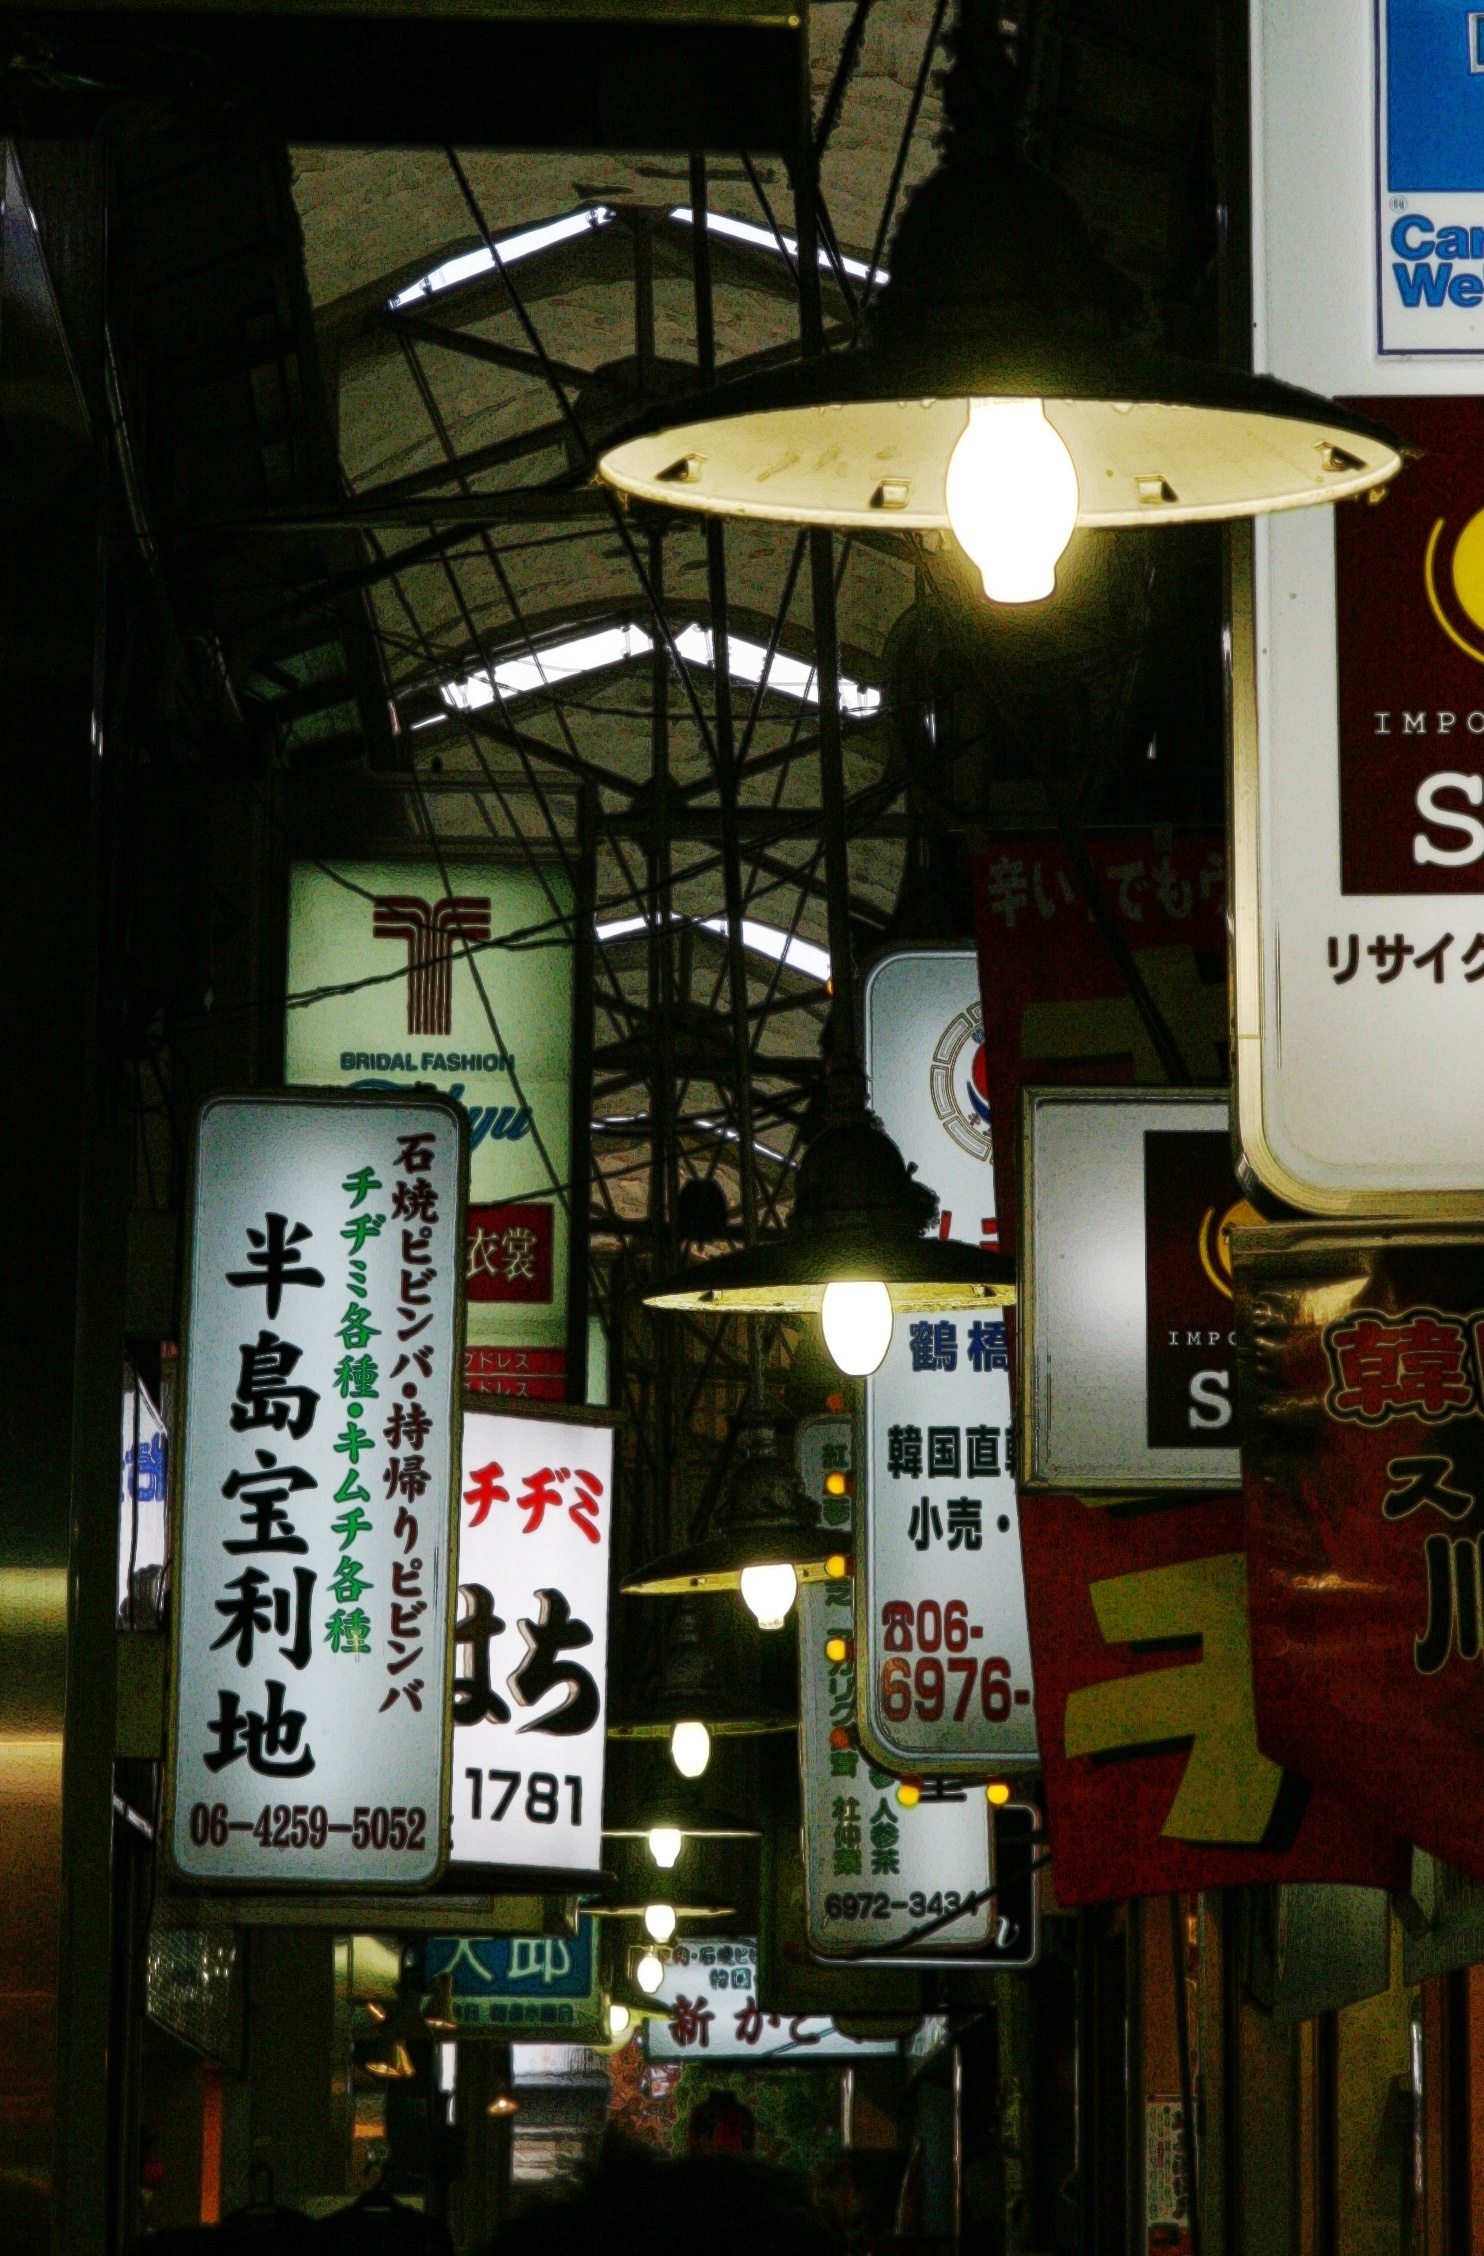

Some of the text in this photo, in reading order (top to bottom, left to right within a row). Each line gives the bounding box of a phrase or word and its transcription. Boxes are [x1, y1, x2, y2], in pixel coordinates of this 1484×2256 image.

[339, 1051, 516, 1073] BRIDAL FASHION
[1328, 1317, 1484, 1413] 韓
[324, 1165, 387, 1656] チヂミ各種・キムチ各種
[203, 1211, 326, 1779] 半島宝利地
[462, 1460, 605, 1545] チヂミ
[880, 1656, 1031, 1723] 6976-
[189, 1804, 427, 1851] 06-4259-5052
[464, 1767, 582, 1826] 1781
